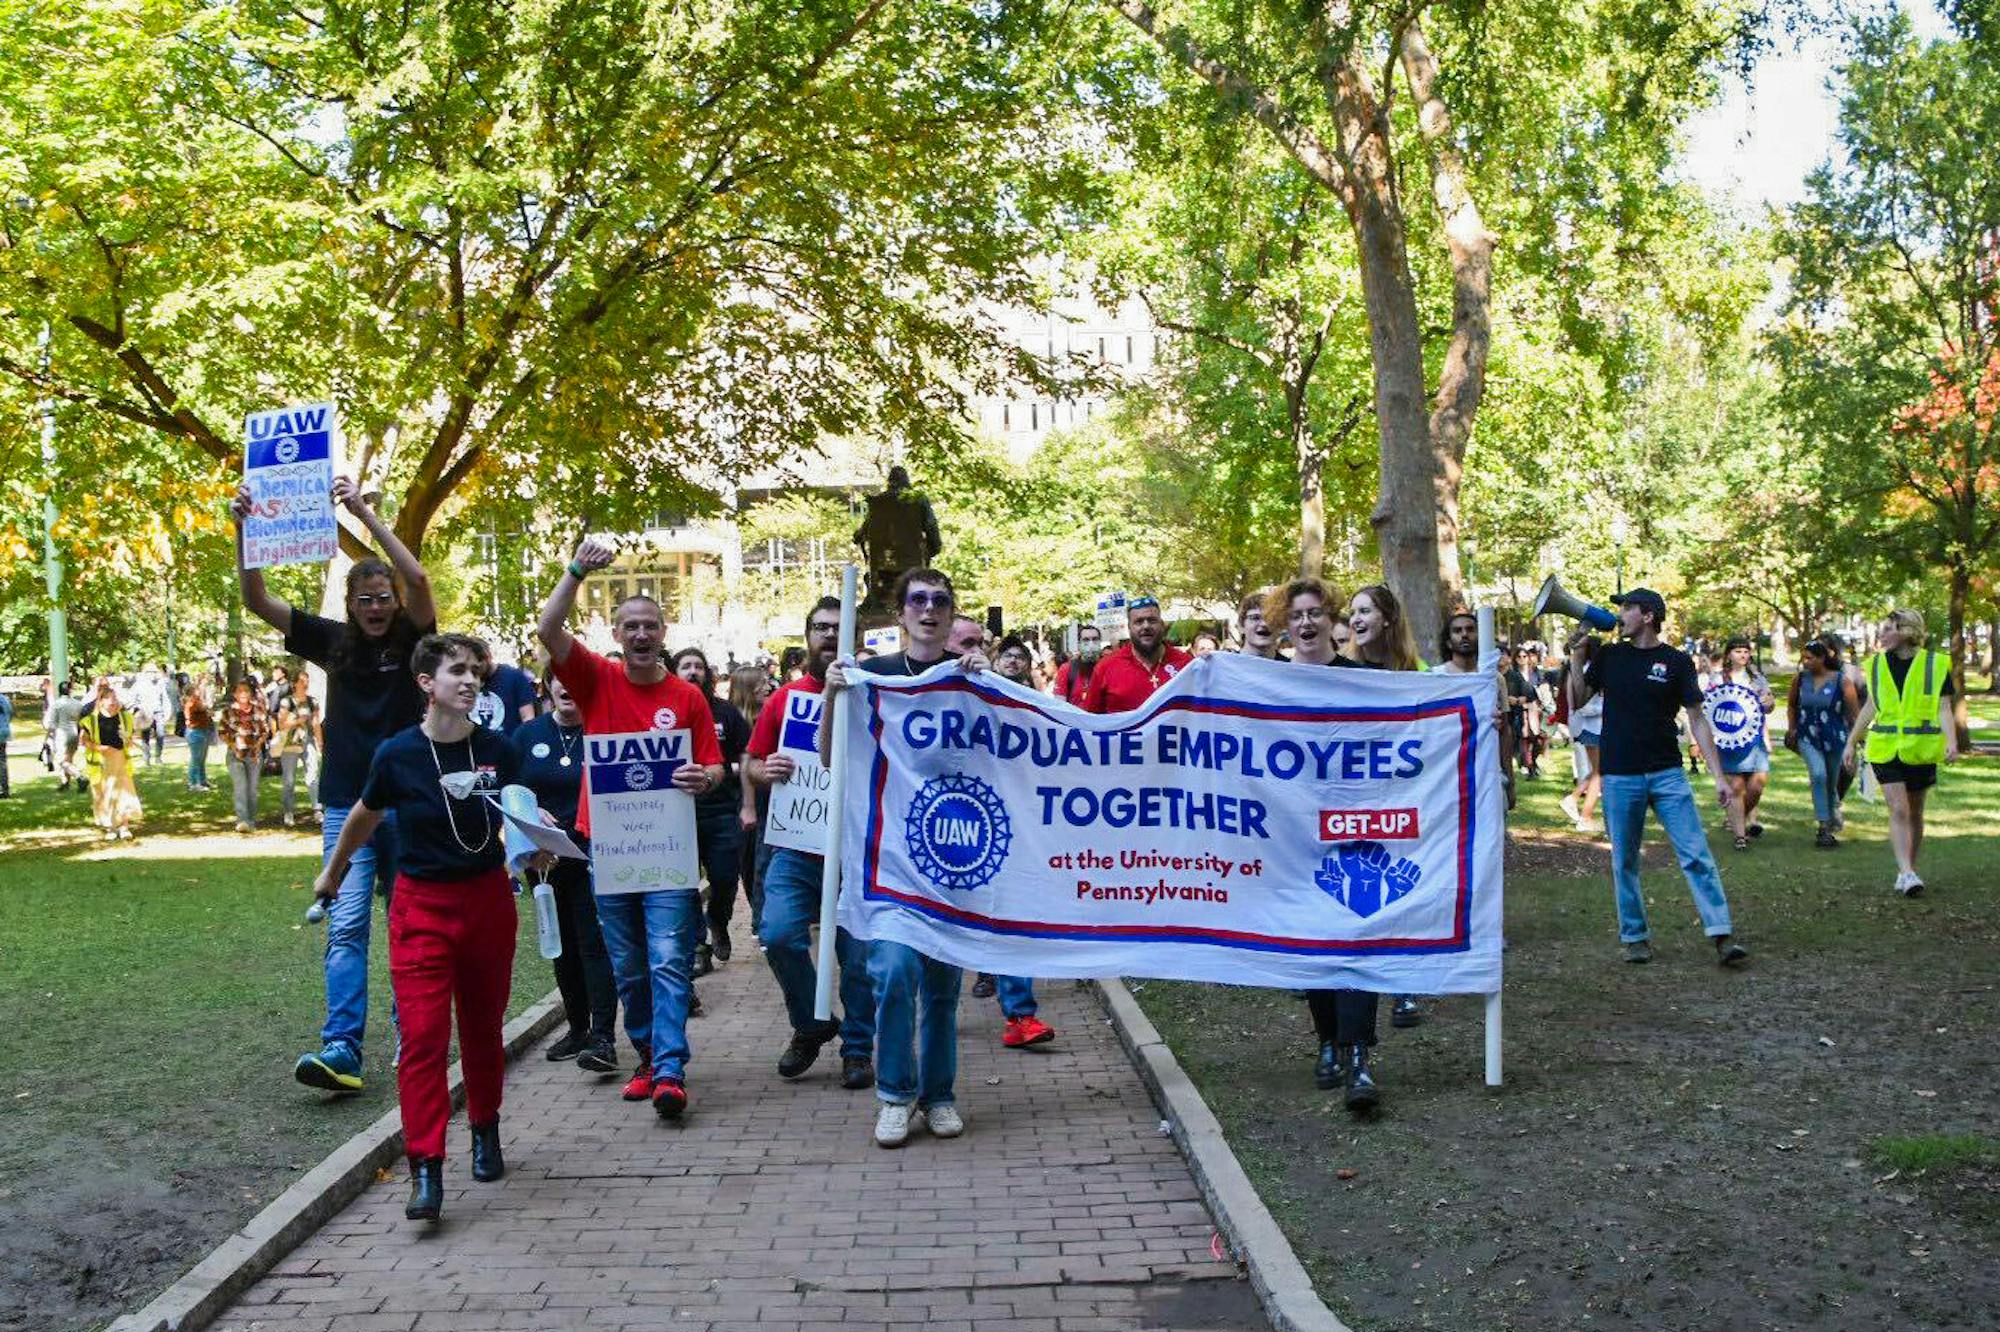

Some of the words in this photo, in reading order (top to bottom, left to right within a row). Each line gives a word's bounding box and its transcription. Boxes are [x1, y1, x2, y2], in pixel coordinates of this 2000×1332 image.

[251, 408, 327, 440] UAW
[1715, 708, 1745, 727] UAW
[590, 735, 683, 764] UAW
[902, 709, 1144, 768] GRADUATE
[1158, 725, 1425, 781] EMPLOYEES
[1036, 786, 1271, 839] TOGETHER
[1326, 813, 1411, 836] GET-UP
[934, 817, 980, 848] UAW
[1048, 852, 1072, 869] at
[1076, 849, 1114, 870] the
[1120, 849, 1234, 878] University
[1239, 859, 1264, 877] of
[1076, 879, 1230, 905] Pennsylvania
